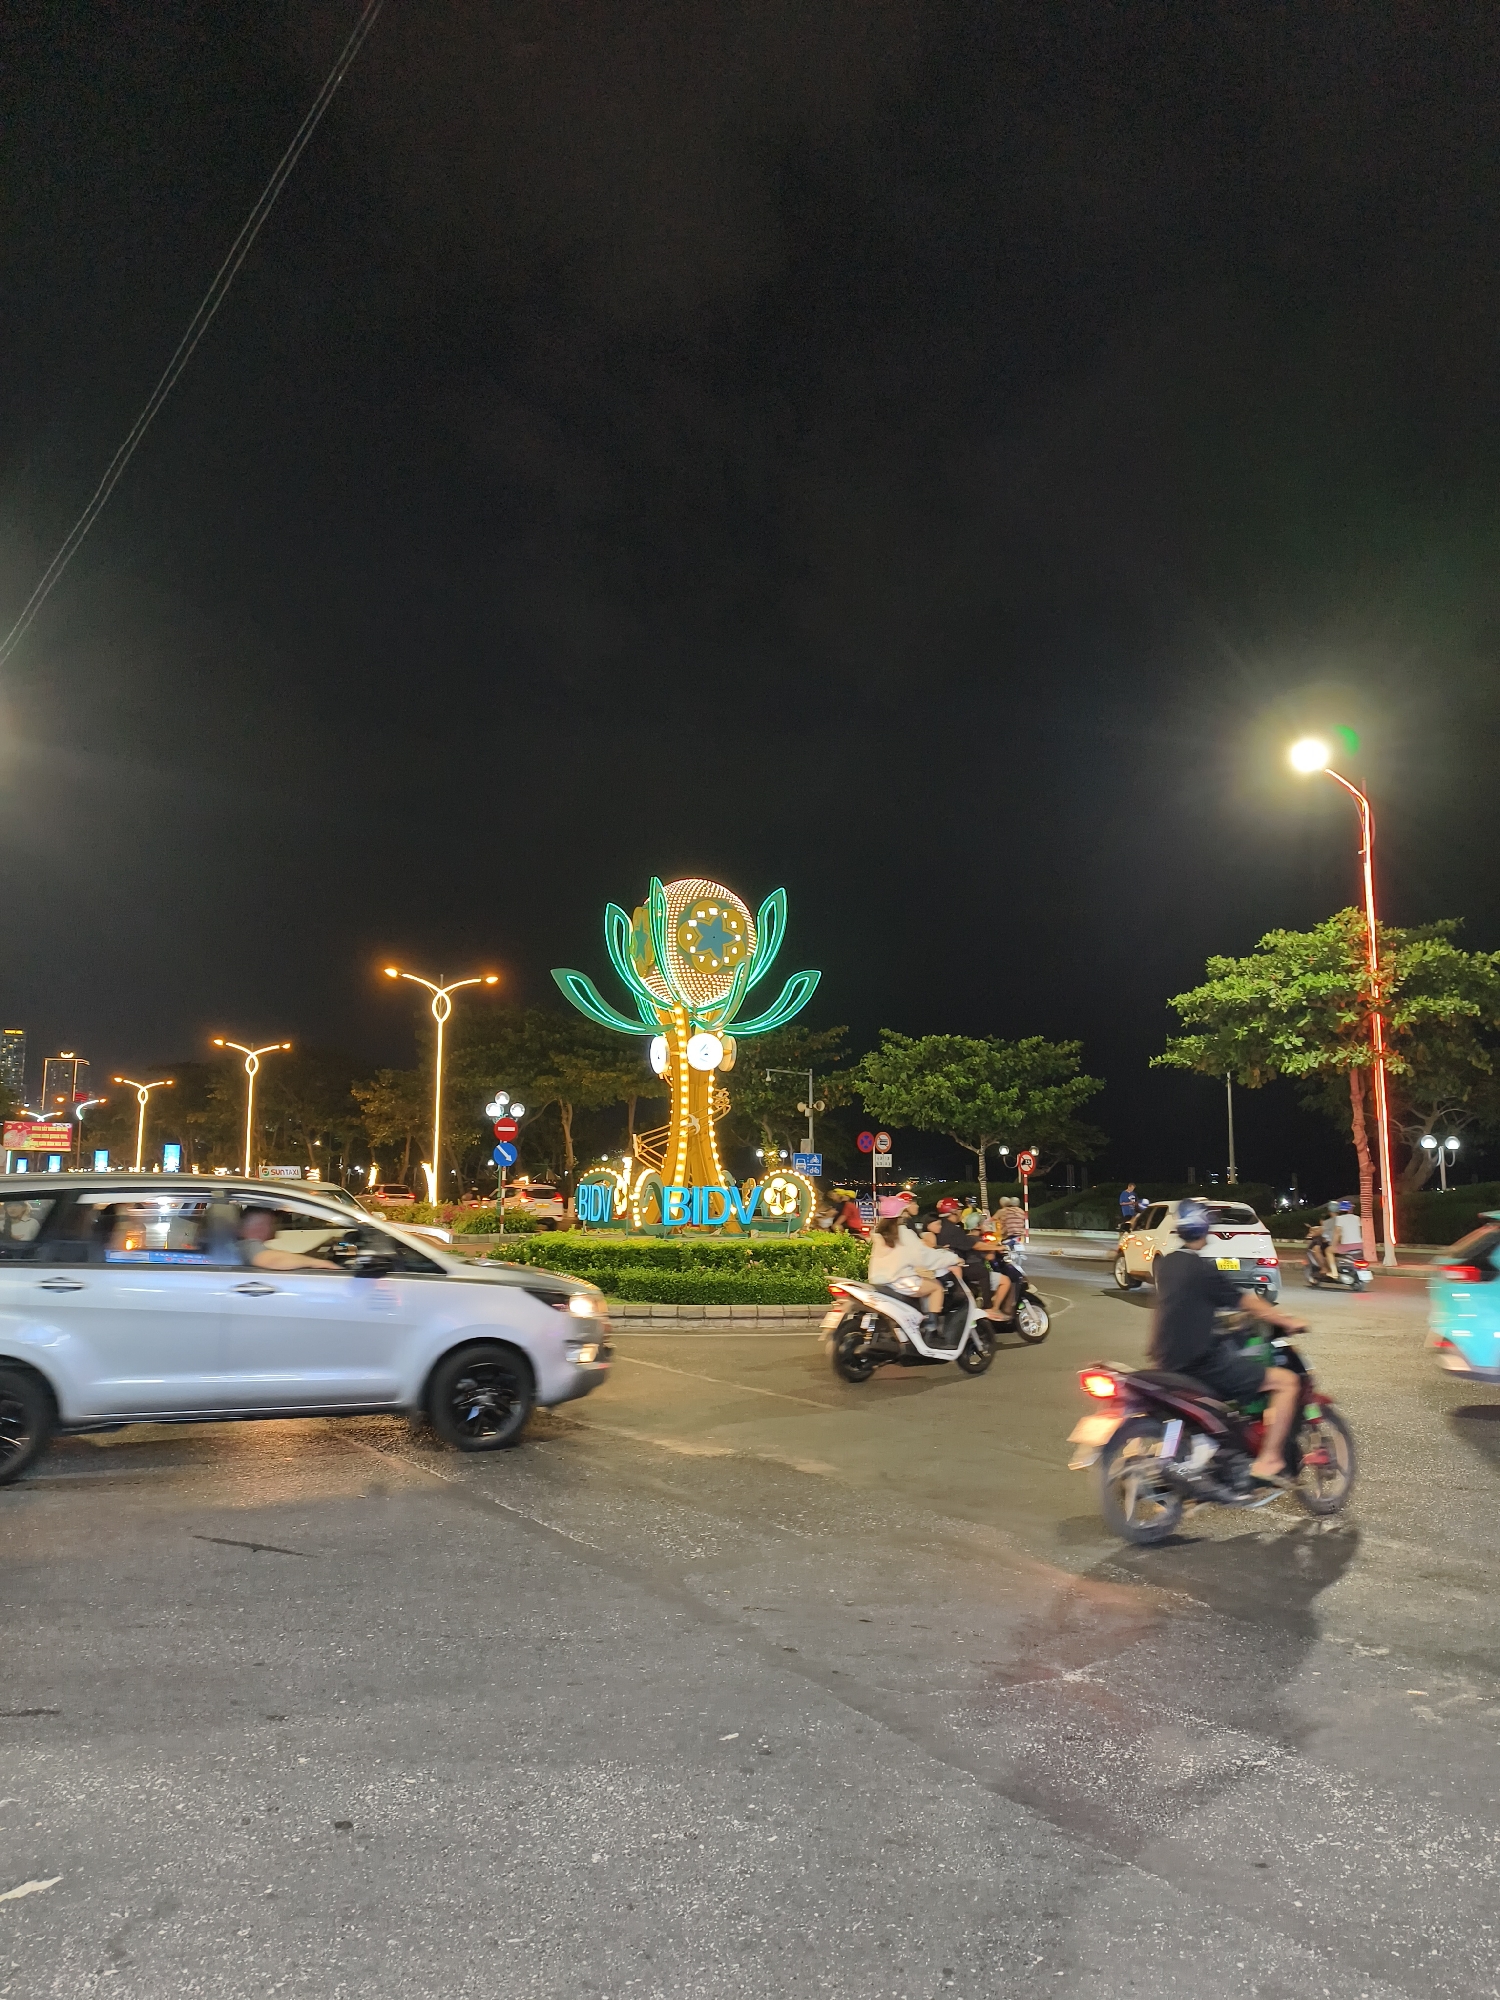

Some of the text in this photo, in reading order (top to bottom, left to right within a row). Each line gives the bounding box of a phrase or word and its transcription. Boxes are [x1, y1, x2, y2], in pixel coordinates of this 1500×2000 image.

[285, 1168, 299, 1176] TAXI
[578, 1184, 613, 1222] BIDV
[662, 1186, 763, 1226] BIDV
